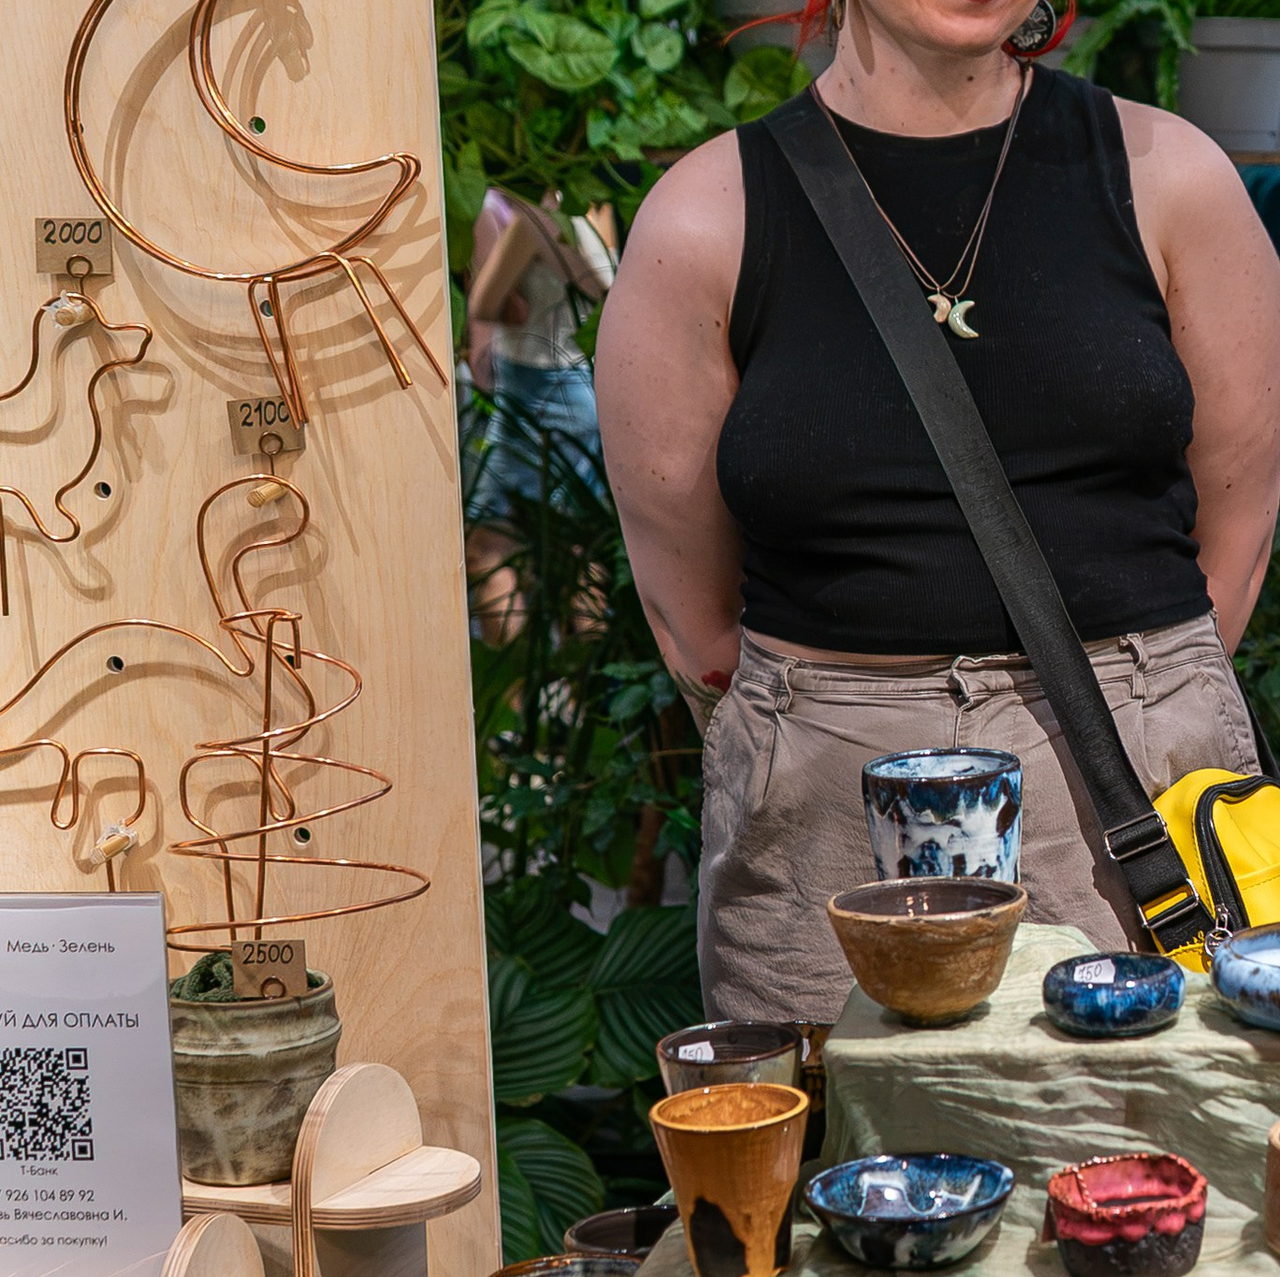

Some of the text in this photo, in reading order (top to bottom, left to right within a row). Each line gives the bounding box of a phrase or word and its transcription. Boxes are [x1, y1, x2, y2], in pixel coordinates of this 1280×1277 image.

[43, 219, 103, 244] 2000
[239, 400, 290, 428] 2100
[6, 939, 116, 954] Медь Зелень
[242, 943, 294, 965] 2500
[21, 1013, 58, 1029] ДЛЯ
[63, 1012, 140, 1028] ОПЛАТЫ
[20, 1165, 59, 1177] Т-Банк
[5, 1189, 30, 1202] 926
[34, 1189, 56, 1202] 104
[59, 1189, 75, 1202] 89
[78, 1189, 95, 1202] 92
[14, 1208, 110, 1221] Вячеславовна
[41, 1236, 55, 1246] за
